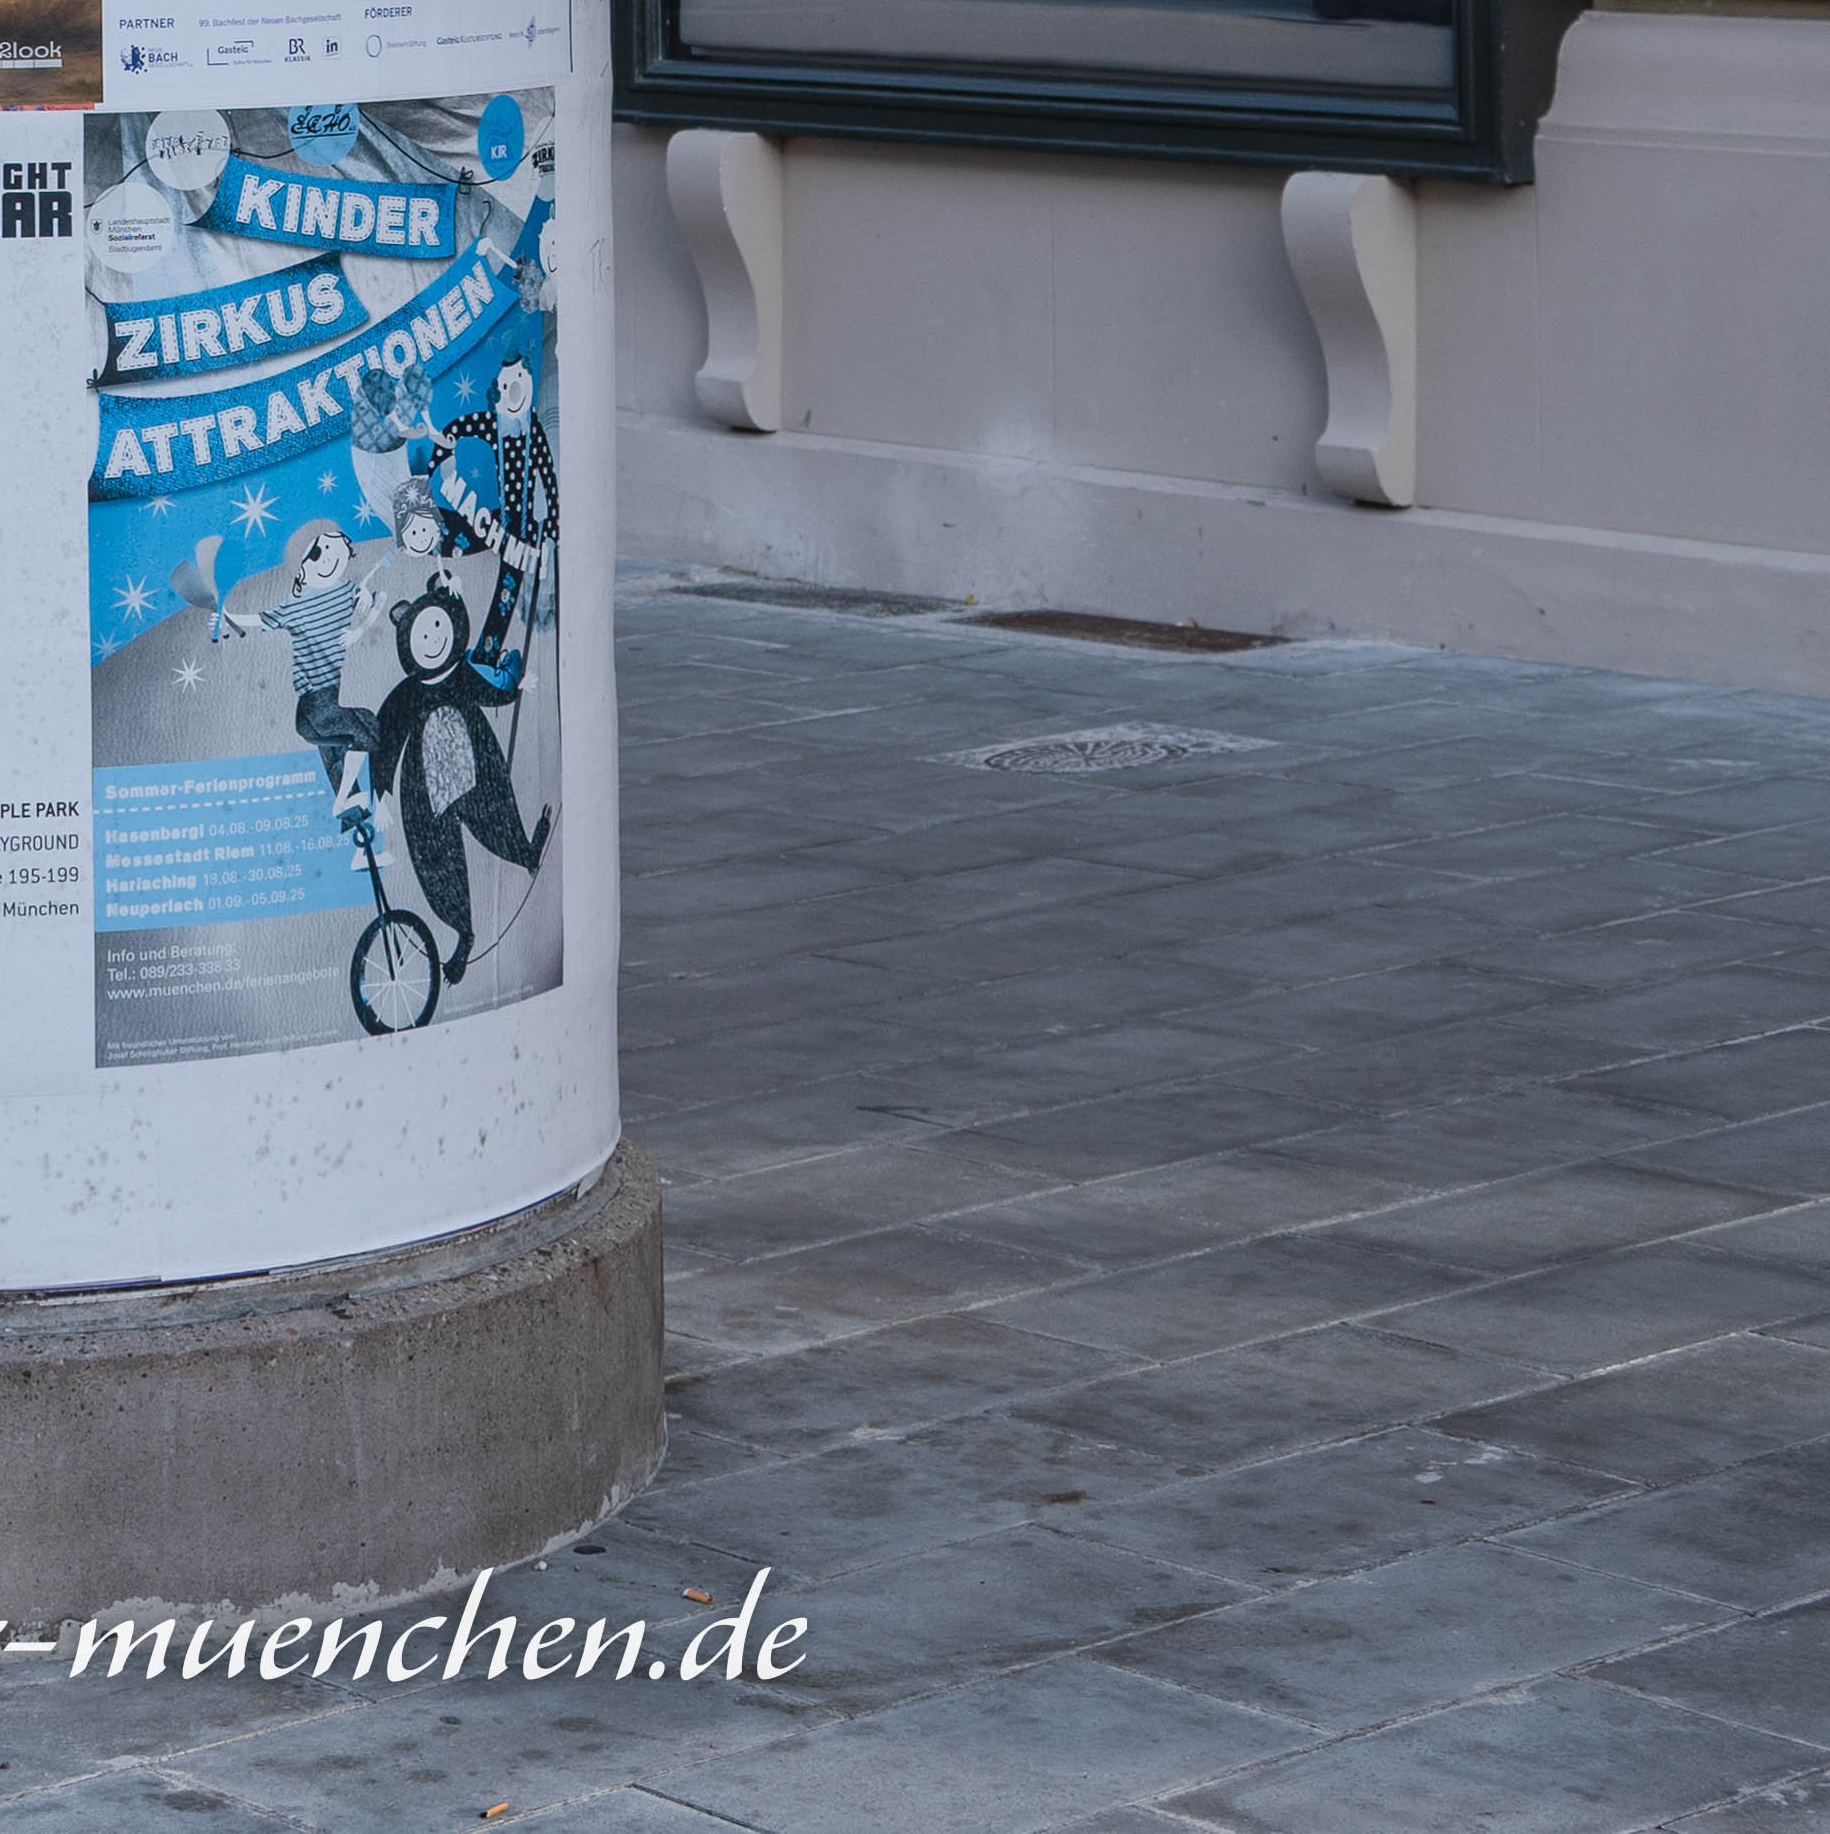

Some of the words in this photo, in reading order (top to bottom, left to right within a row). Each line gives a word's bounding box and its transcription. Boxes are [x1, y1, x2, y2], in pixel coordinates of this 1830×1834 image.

[235, 175, 440, 248] KINDER
[115, 273, 345, 372] ZIRKUS
[104, 261, 495, 480] ATTRAKTIONEN
[35, 801, 80, 819] PARK
[3, 900, 80, 918] München
